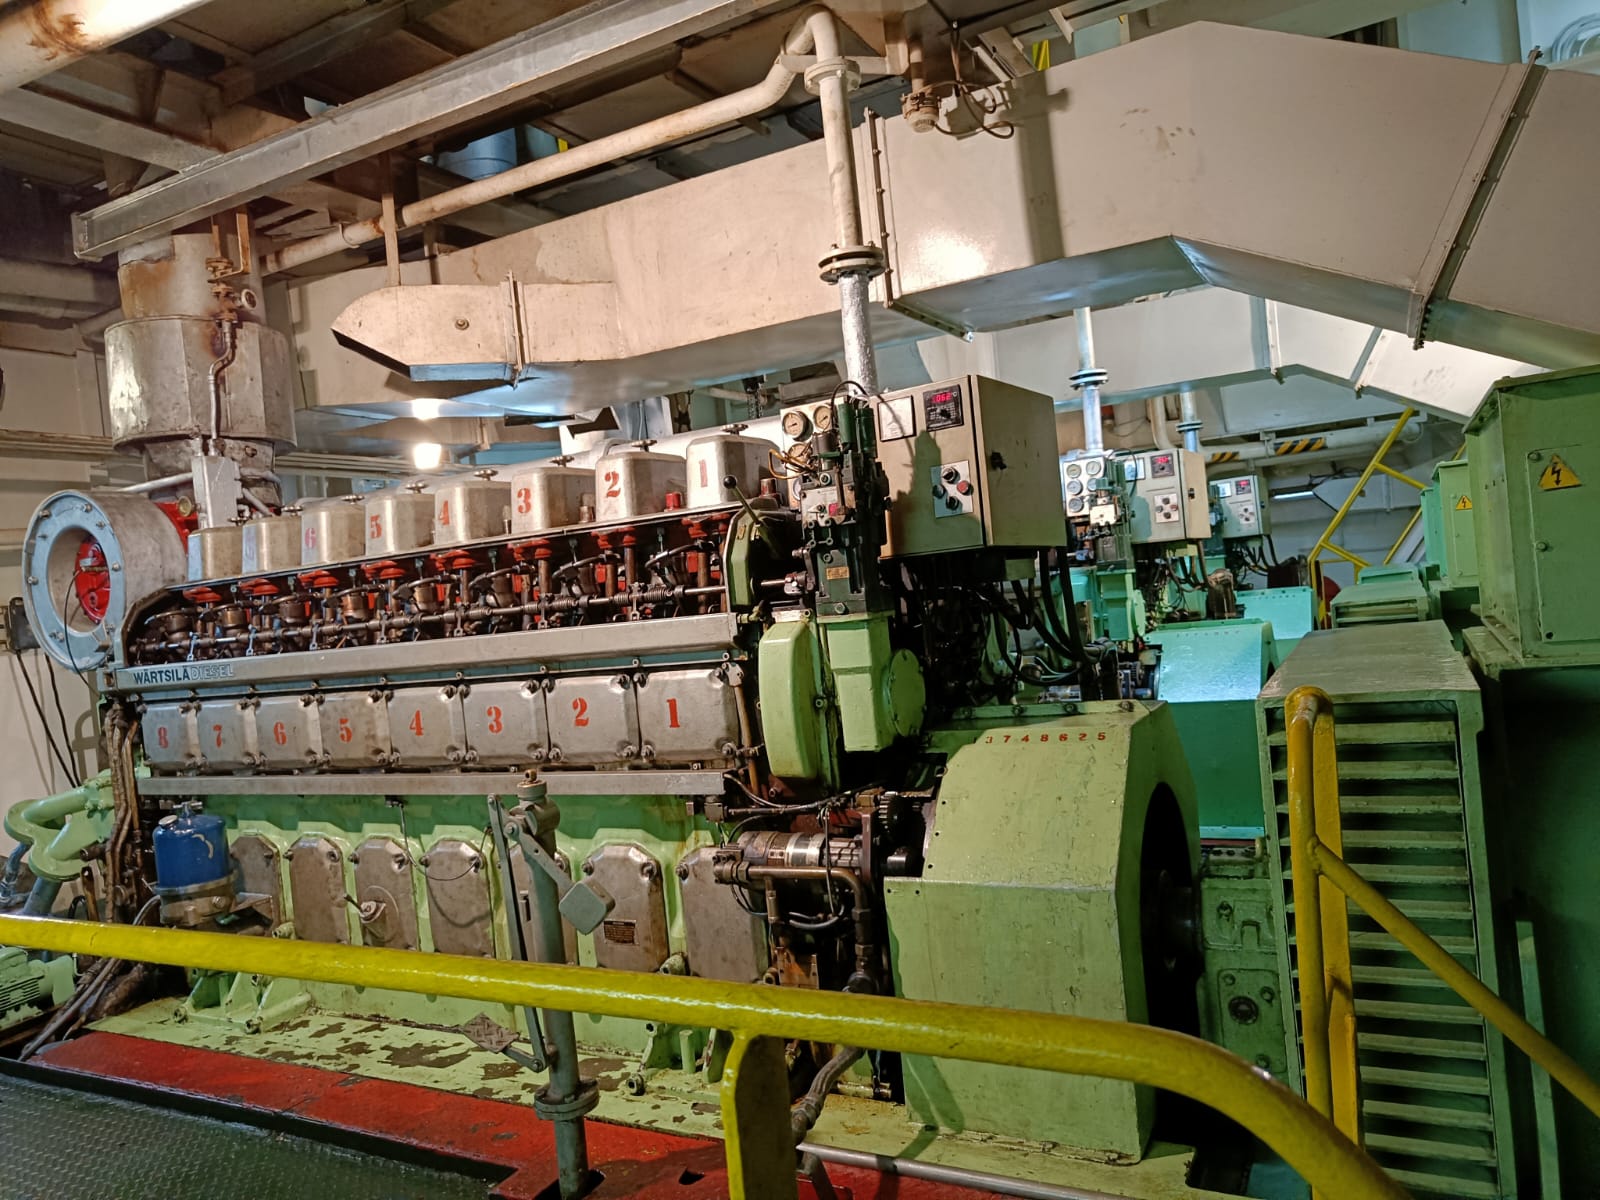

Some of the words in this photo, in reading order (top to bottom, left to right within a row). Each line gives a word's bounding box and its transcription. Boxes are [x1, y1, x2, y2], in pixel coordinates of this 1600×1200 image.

[604, 470, 621, 498] 2
[699, 459, 708, 488] 1
[438, 500, 451, 526] 4
[516, 487, 533, 514] 3
[304, 527, 318, 549] 6
[369, 515, 383, 540] 5
[409, 710, 424, 737] 4
[486, 706, 503, 735] 3
[571, 697, 590, 728] 2
[665, 698, 681, 729] 1
[158, 726, 170, 747] 8
[213, 725, 223, 747] 7
[273, 722, 287, 746] 6
[339, 717, 353, 743] 5
